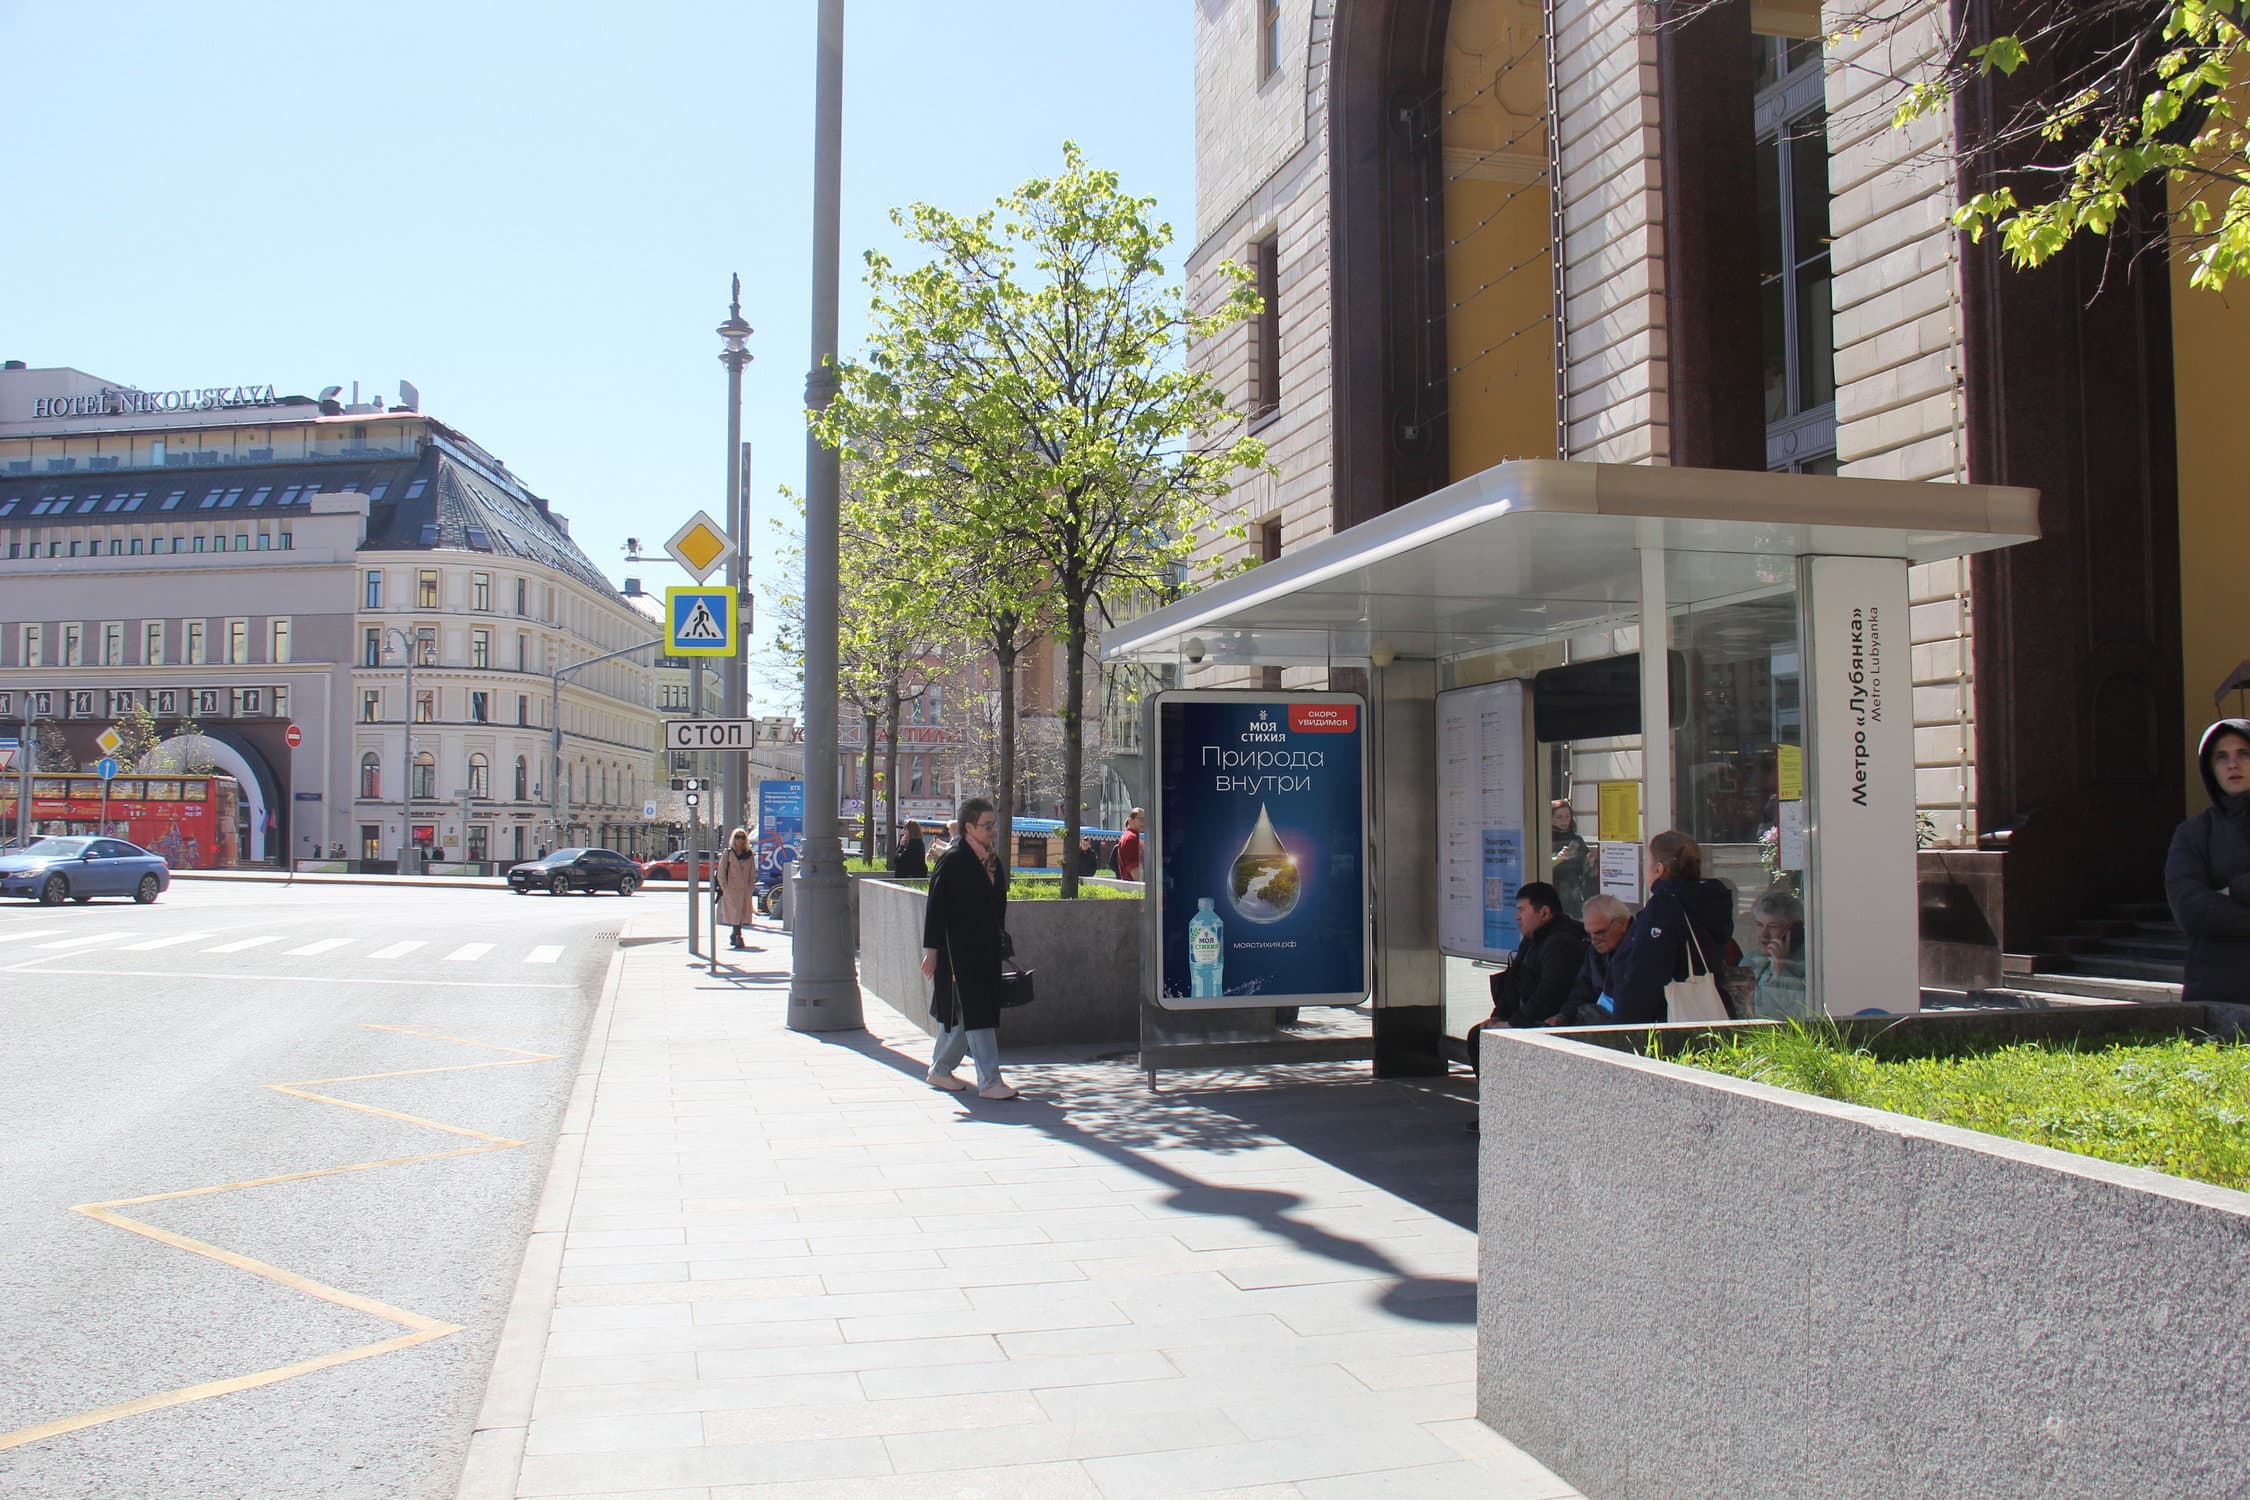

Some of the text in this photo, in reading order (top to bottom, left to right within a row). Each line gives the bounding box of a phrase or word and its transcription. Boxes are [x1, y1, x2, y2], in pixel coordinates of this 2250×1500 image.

[32, 384, 277, 418] HOTEL NIKOL'SKAYA
[1867, 606, 1882, 722] Metro Lubyanka
[1849, 607, 1869, 807] Метро «Лубянка»
[1250, 722, 1277, 731] МОЯ
[1298, 719, 1348, 727] УВИДИМСЯ
[678, 725, 742, 745] СТОП
[1241, 733, 1286, 742] СТИХИЯ
[1202, 746, 1324, 771] Природа
[1216, 775, 1311, 796] внутри
